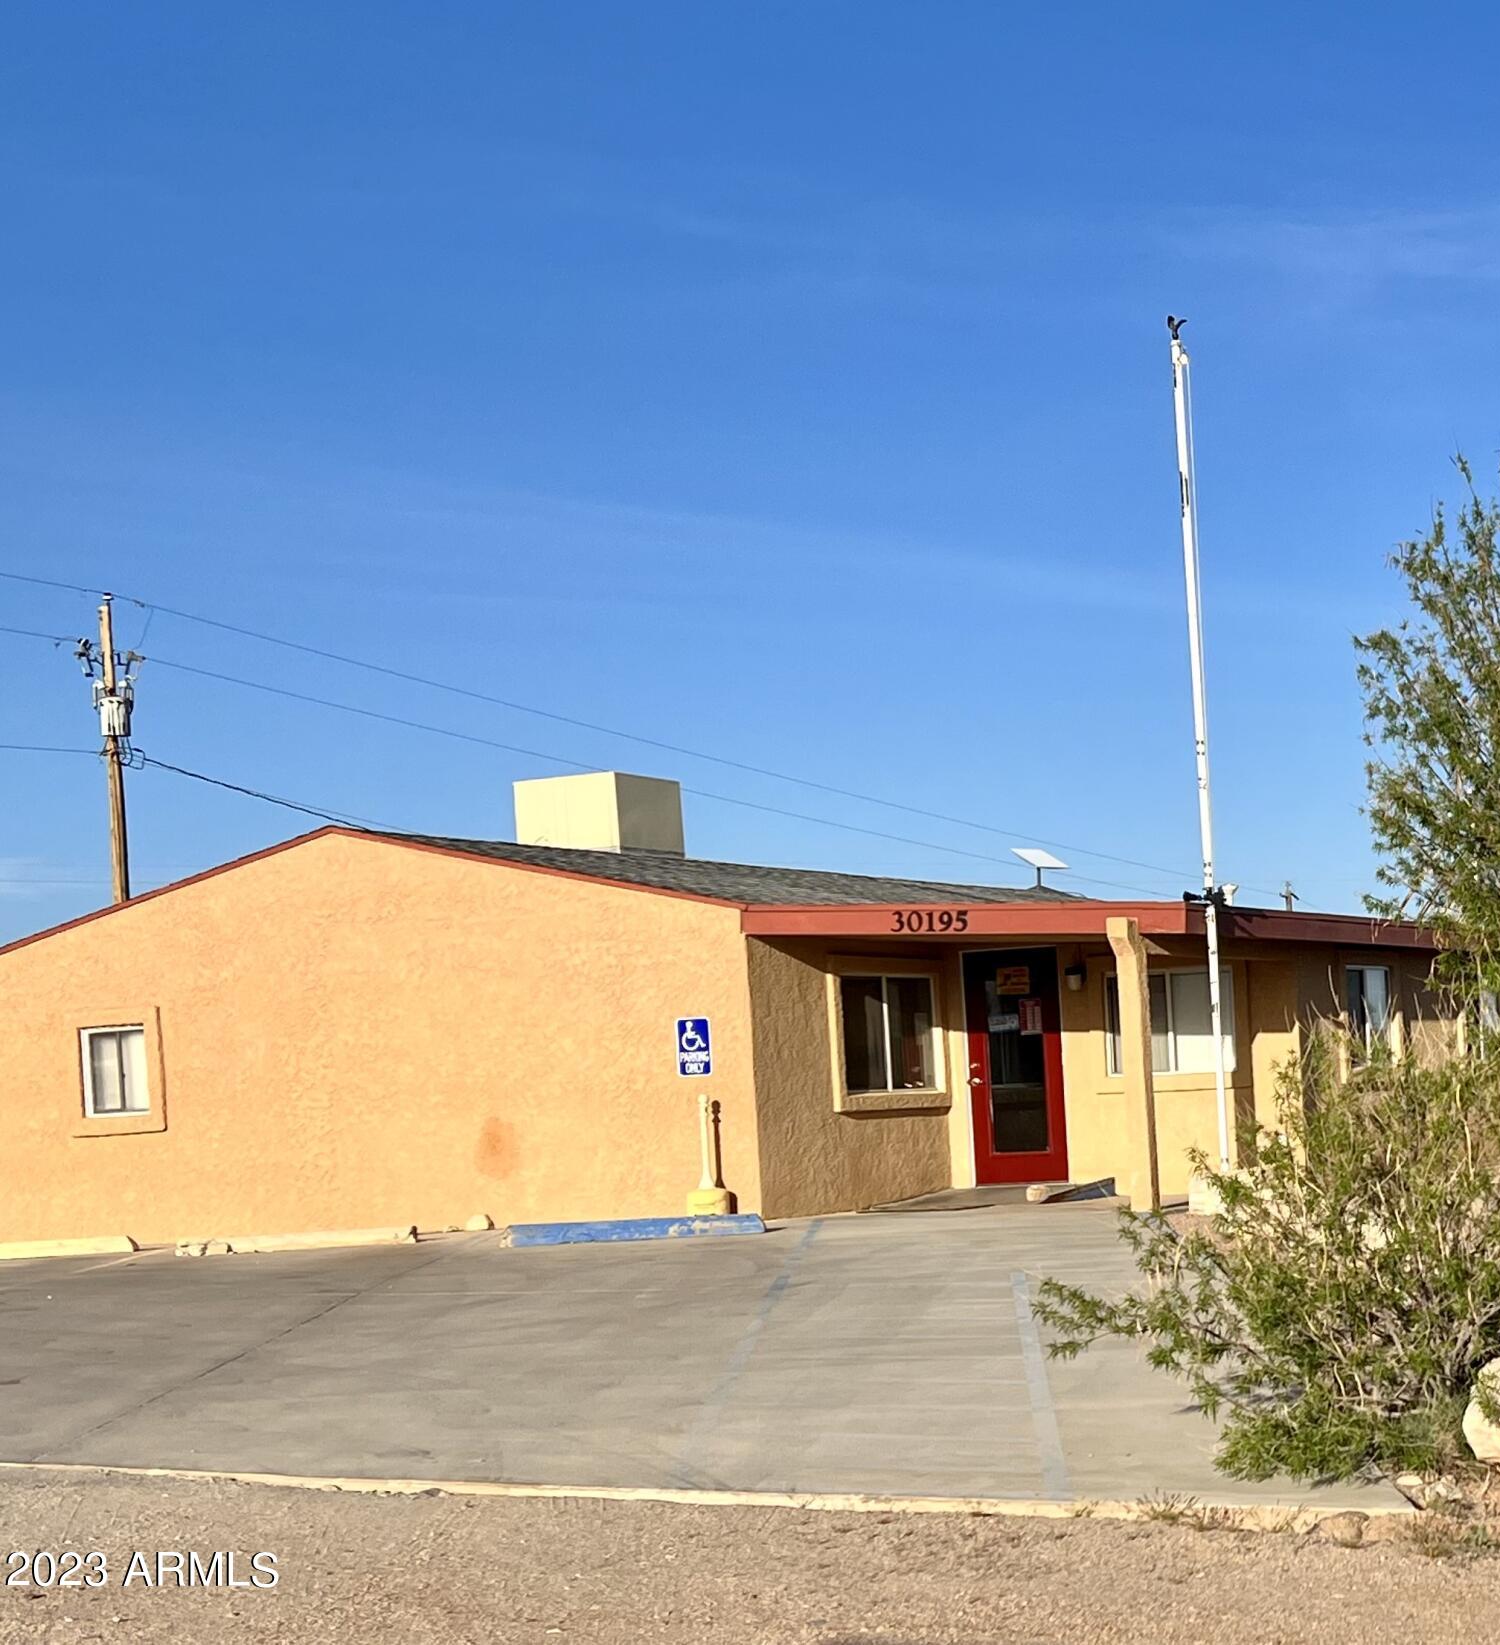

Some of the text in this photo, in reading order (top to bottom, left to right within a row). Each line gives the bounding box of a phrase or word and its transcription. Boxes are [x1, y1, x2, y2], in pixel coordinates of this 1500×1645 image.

[890, 910, 969, 932] 30195
[680, 1050, 710, 1063] PARKING
[685, 1062, 705, 1073] ONLY
